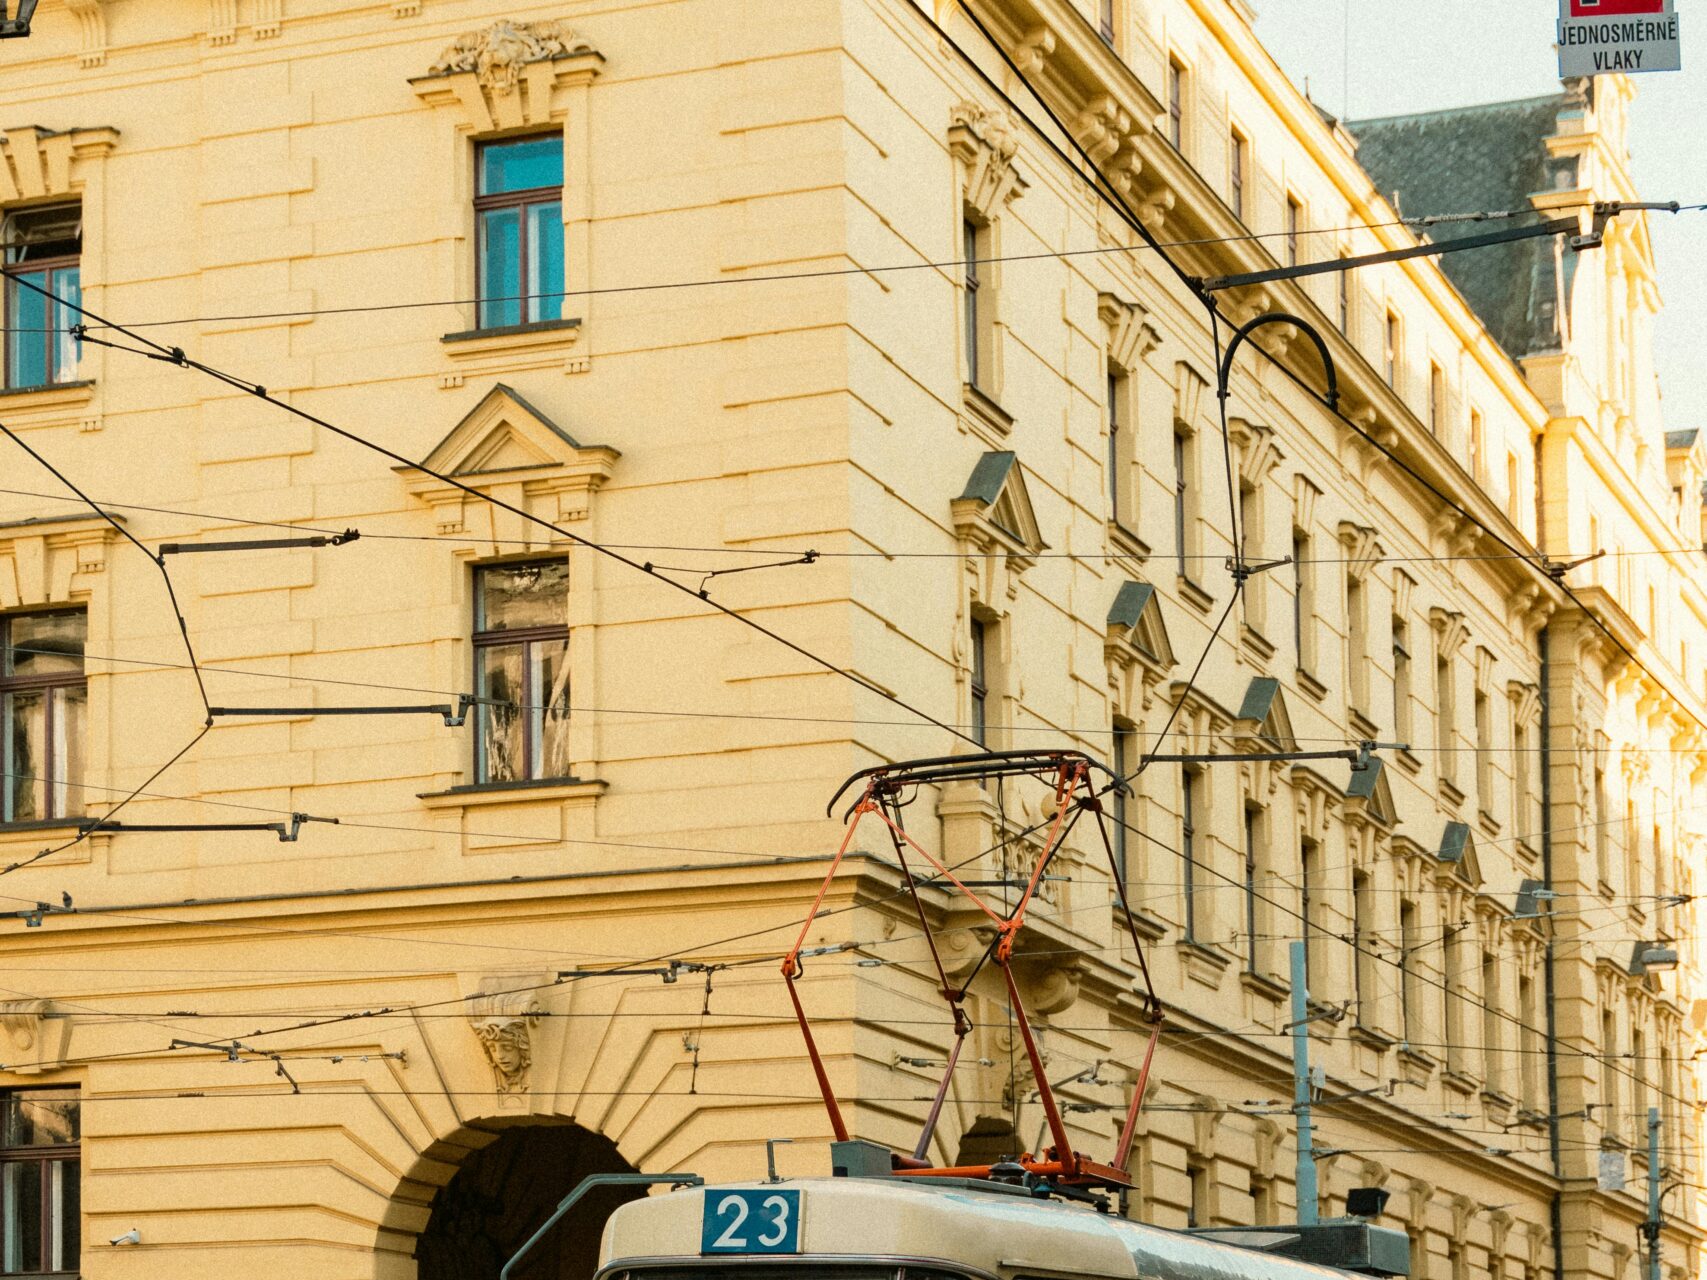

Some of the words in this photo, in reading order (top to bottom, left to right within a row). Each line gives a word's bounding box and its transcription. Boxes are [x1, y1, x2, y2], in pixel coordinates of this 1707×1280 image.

[1559, 18, 1677, 46] JEDNOSMĚRNÉ
[1593, 50, 1643, 71] VLAKY
[712, 1194, 789, 1247] 23
